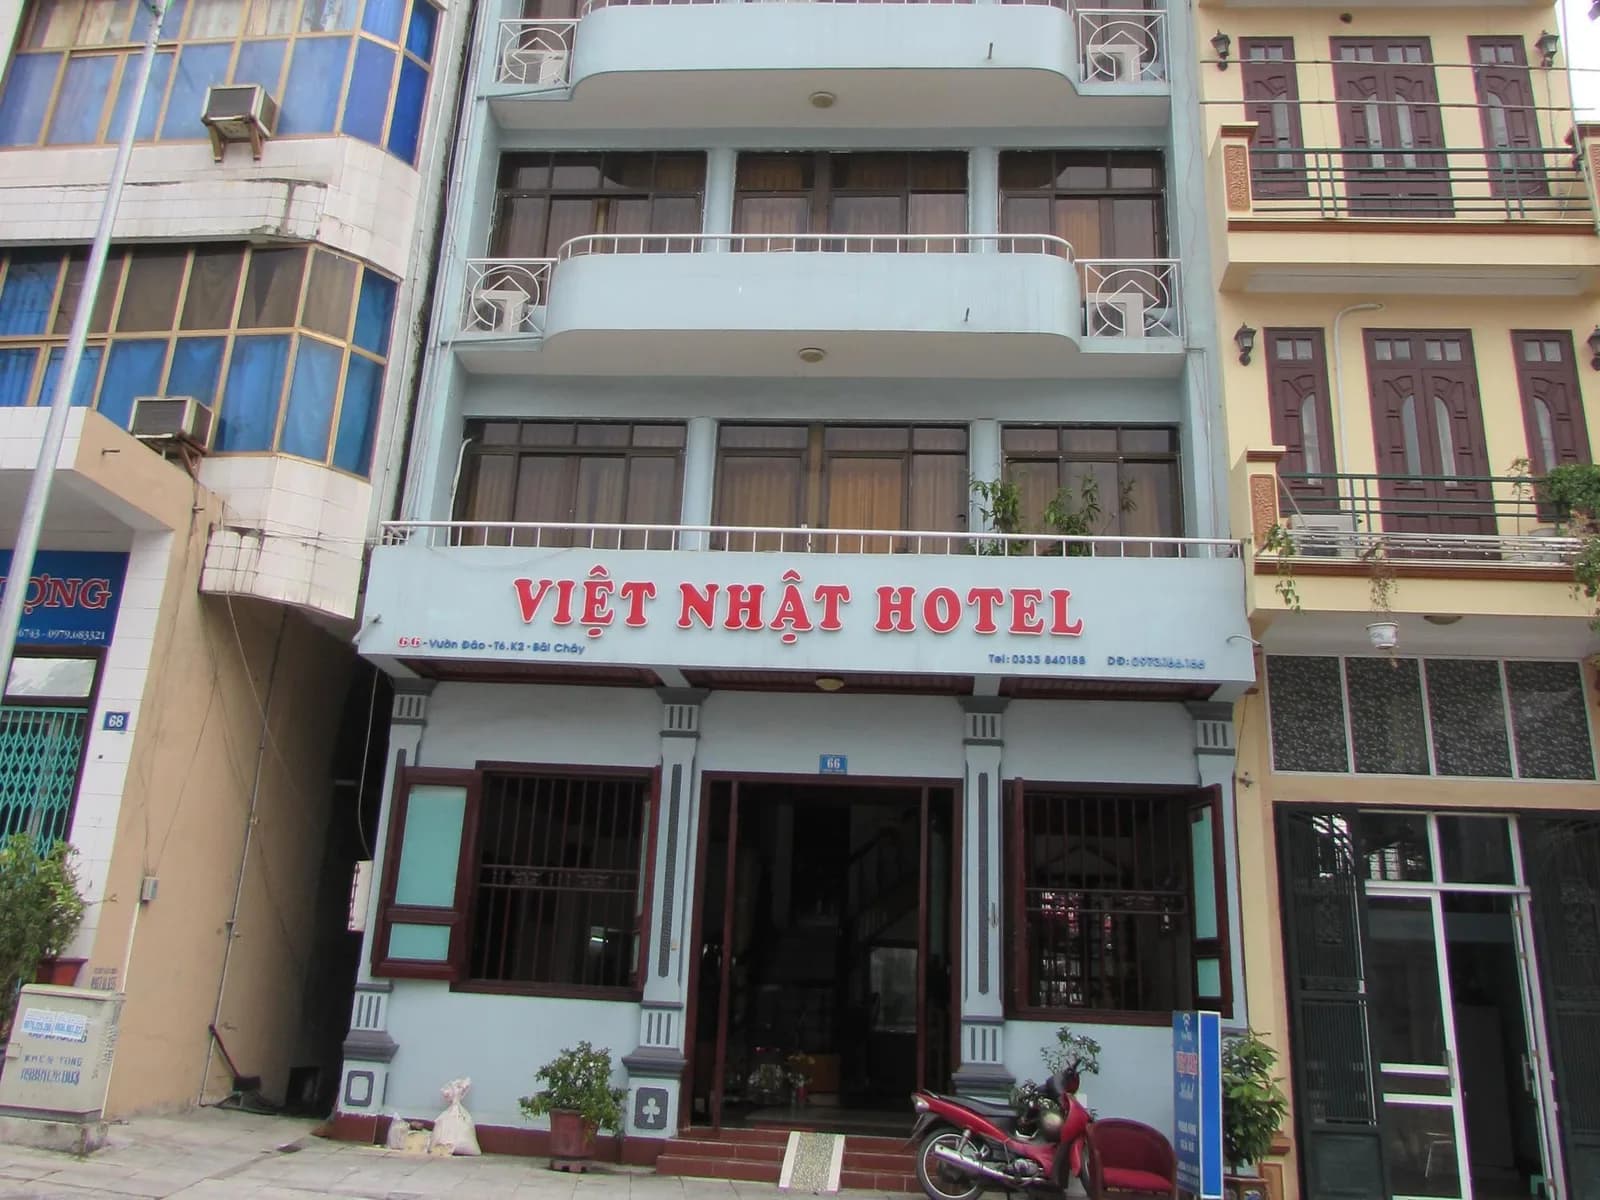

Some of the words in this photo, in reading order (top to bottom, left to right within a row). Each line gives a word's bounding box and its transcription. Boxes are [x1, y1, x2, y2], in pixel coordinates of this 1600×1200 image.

[513, 564, 656, 638] VIỆT
[677, 567, 852, 644] NHẬT
[874, 585, 1084, 637] HOTEL
[109, 714, 124, 728] 68
[826, 758, 840, 769] 66
